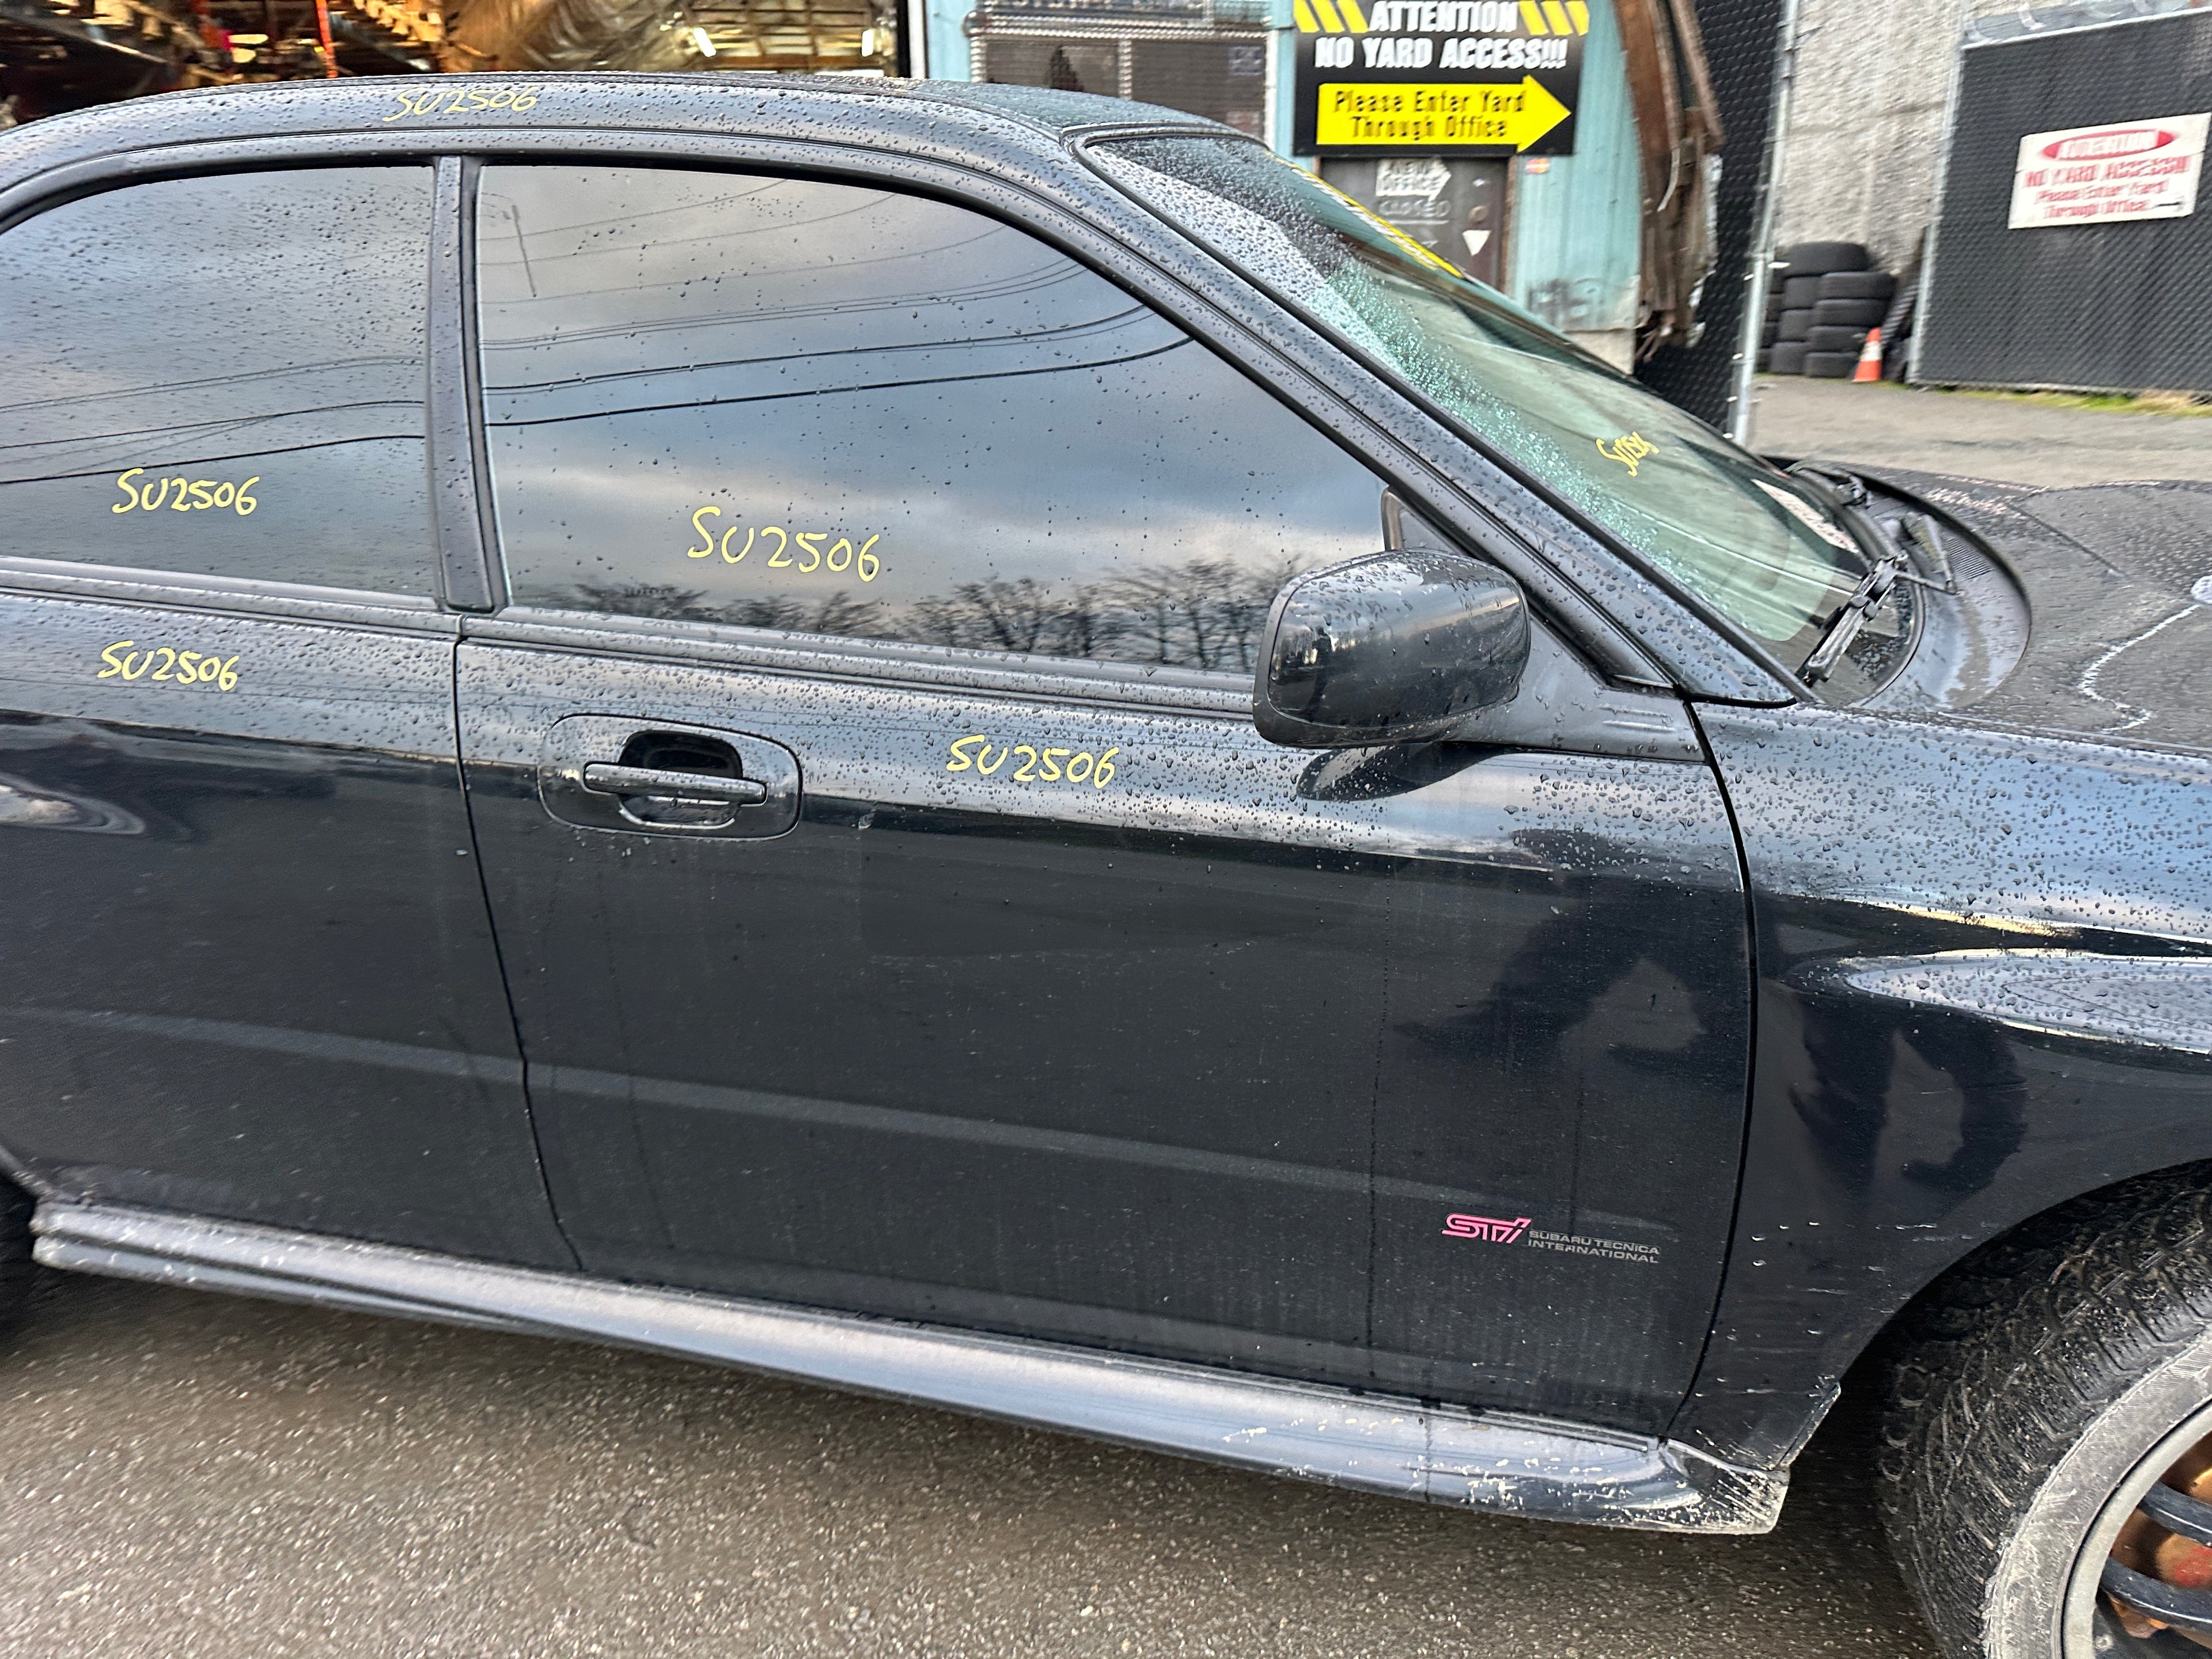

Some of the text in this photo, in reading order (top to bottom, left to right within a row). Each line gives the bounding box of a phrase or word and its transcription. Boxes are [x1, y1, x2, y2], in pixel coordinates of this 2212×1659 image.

[1369, 1, 1518, 32] ATTENTION
[1315, 37, 1567, 69] NO YARD ACCESS!!!
[382, 86, 539, 122] SU2506
[1334, 90, 1527, 112] Please Enter Yard
[1350, 115, 1508, 141] Through Office
[112, 468, 259, 516] SU2506
[687, 506, 880, 582] SU2506
[97, 640, 239, 691] SU2506
[946, 734, 1119, 789] SU2506
[1528, 1230, 1660, 1255] SUBARU TECNICA
[1528, 1238, 1659, 1264] INTERNATIONAL
